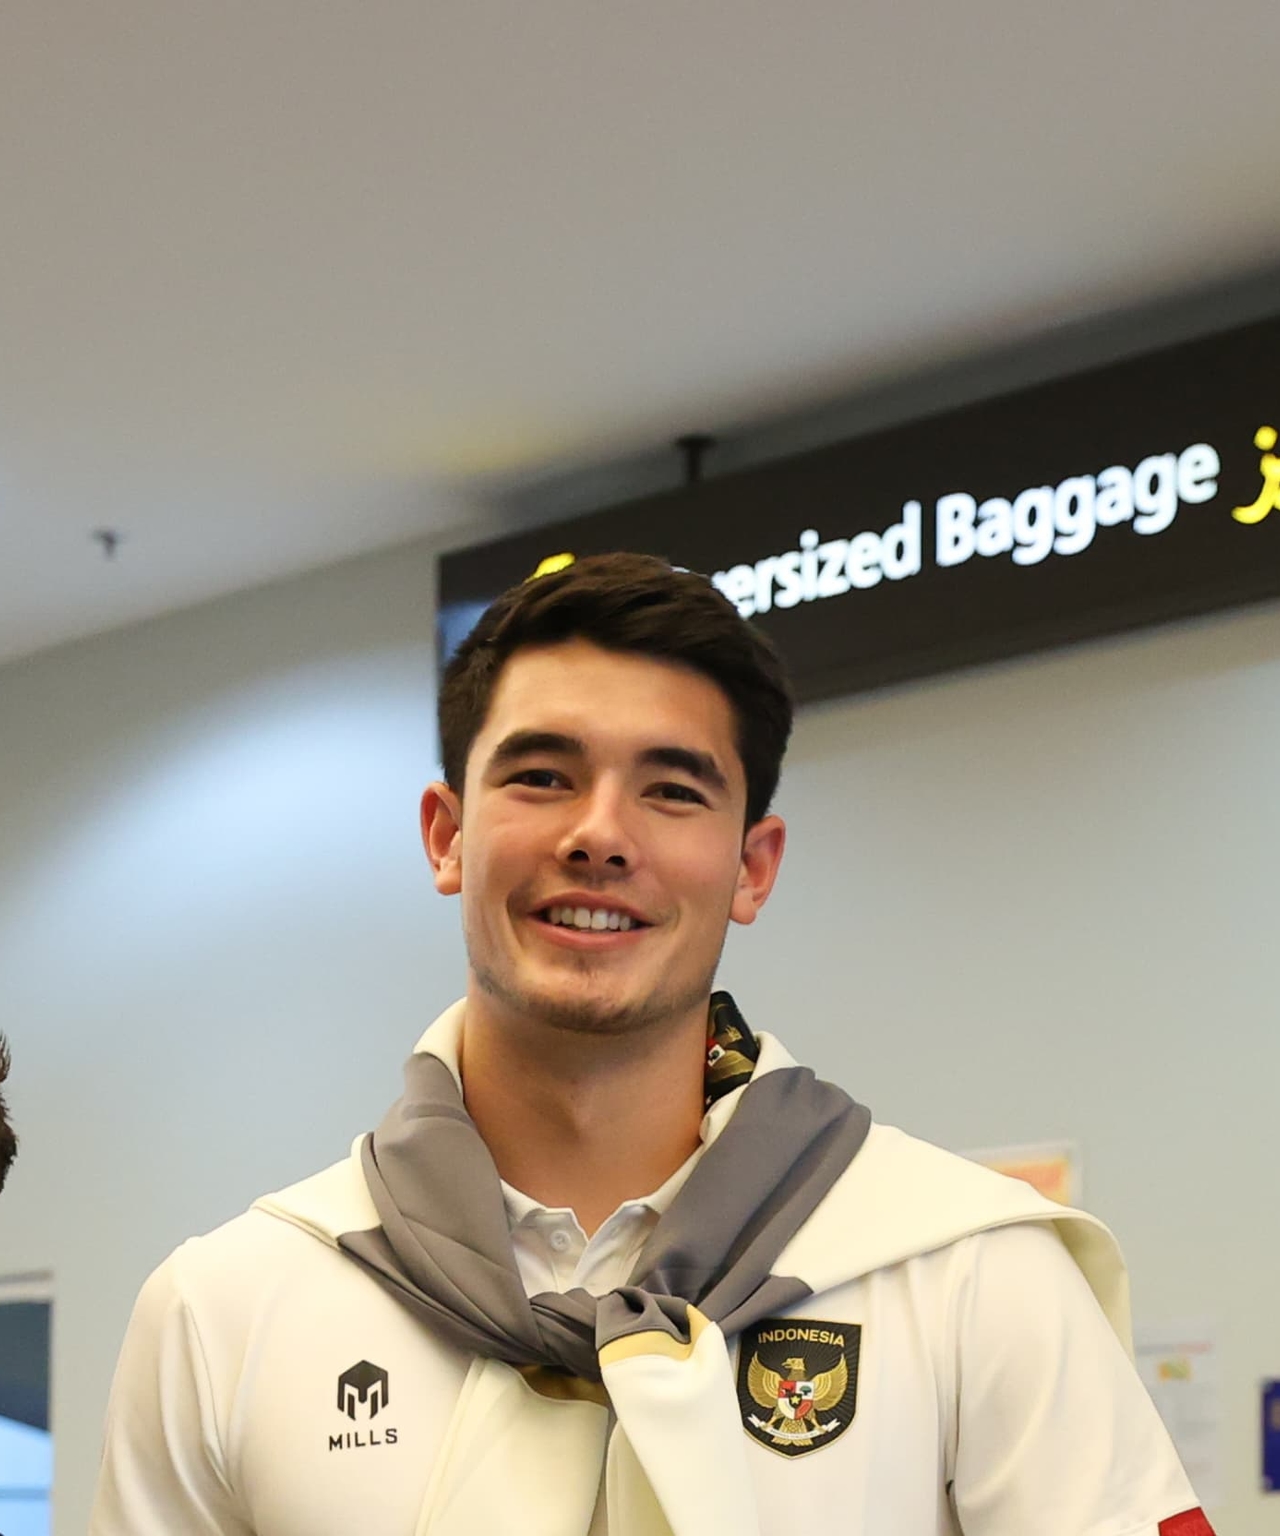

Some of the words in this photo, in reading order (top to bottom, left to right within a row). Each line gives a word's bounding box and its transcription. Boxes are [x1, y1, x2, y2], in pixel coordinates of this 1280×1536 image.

[710, 500, 922, 620] ersized
[935, 443, 1220, 567] Baggage
[757, 1328, 845, 1348] INDONESIA
[328, 1427, 398, 1452] MILLS
